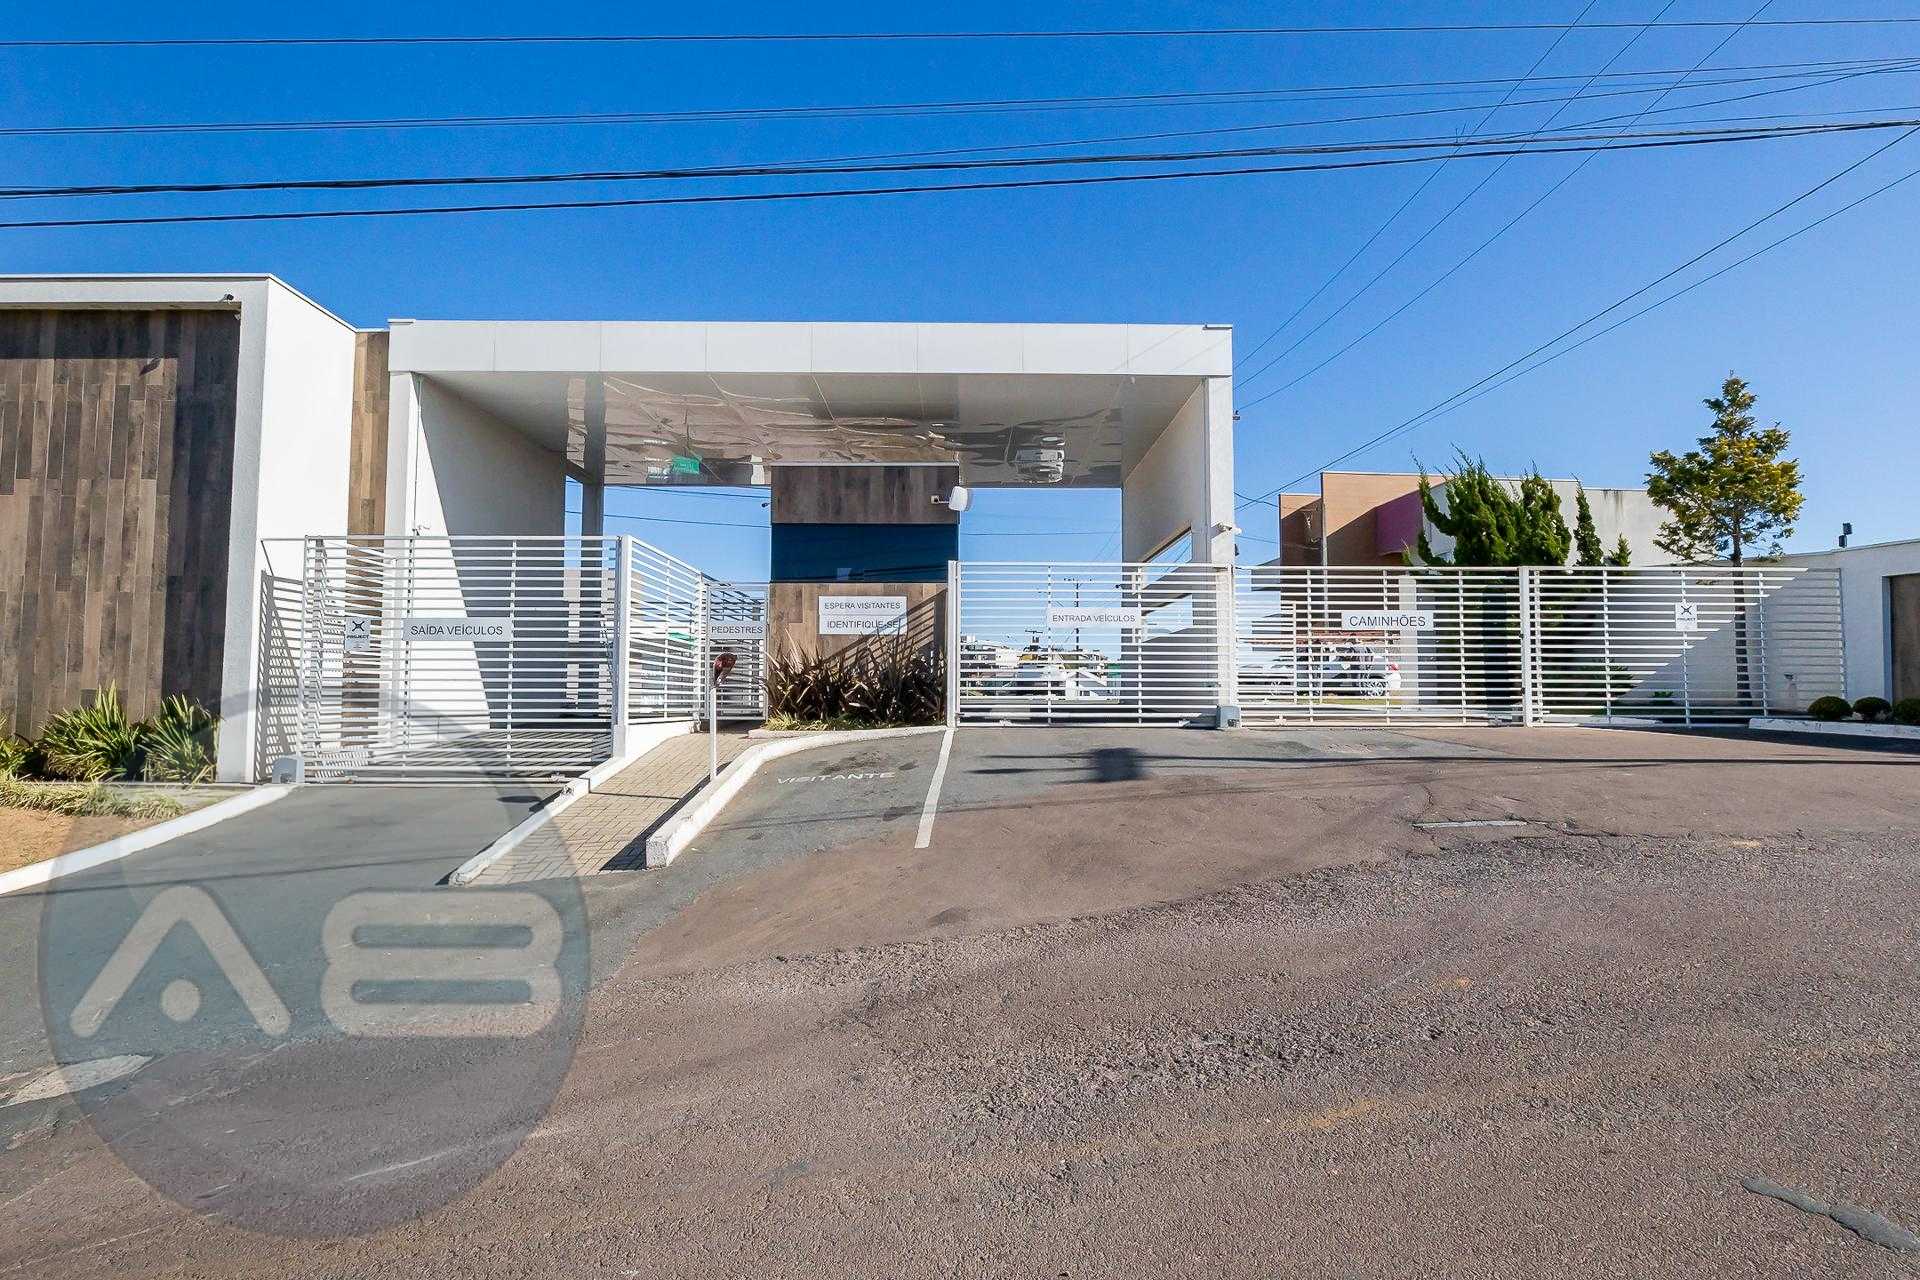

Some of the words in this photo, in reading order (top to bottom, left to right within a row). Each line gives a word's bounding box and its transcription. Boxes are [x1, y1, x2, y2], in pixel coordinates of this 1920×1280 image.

[824, 601, 855, 610] ESPERA
[857, 601, 901, 610] VISITANTES
[1052, 614, 1092, 622] ENTRADA
[1093, 613, 1136, 622] VEÍCULOS
[1349, 614, 1426, 627] CAMINHÕES
[711, 624, 763, 635] PEDESTRES
[827, 620, 899, 629] IDENTIFIQUE-SE
[410, 625, 450, 636] SAÍDA
[450, 625, 503, 636] VEÍCULOS
[777, 772, 896, 784] VISITANTE
